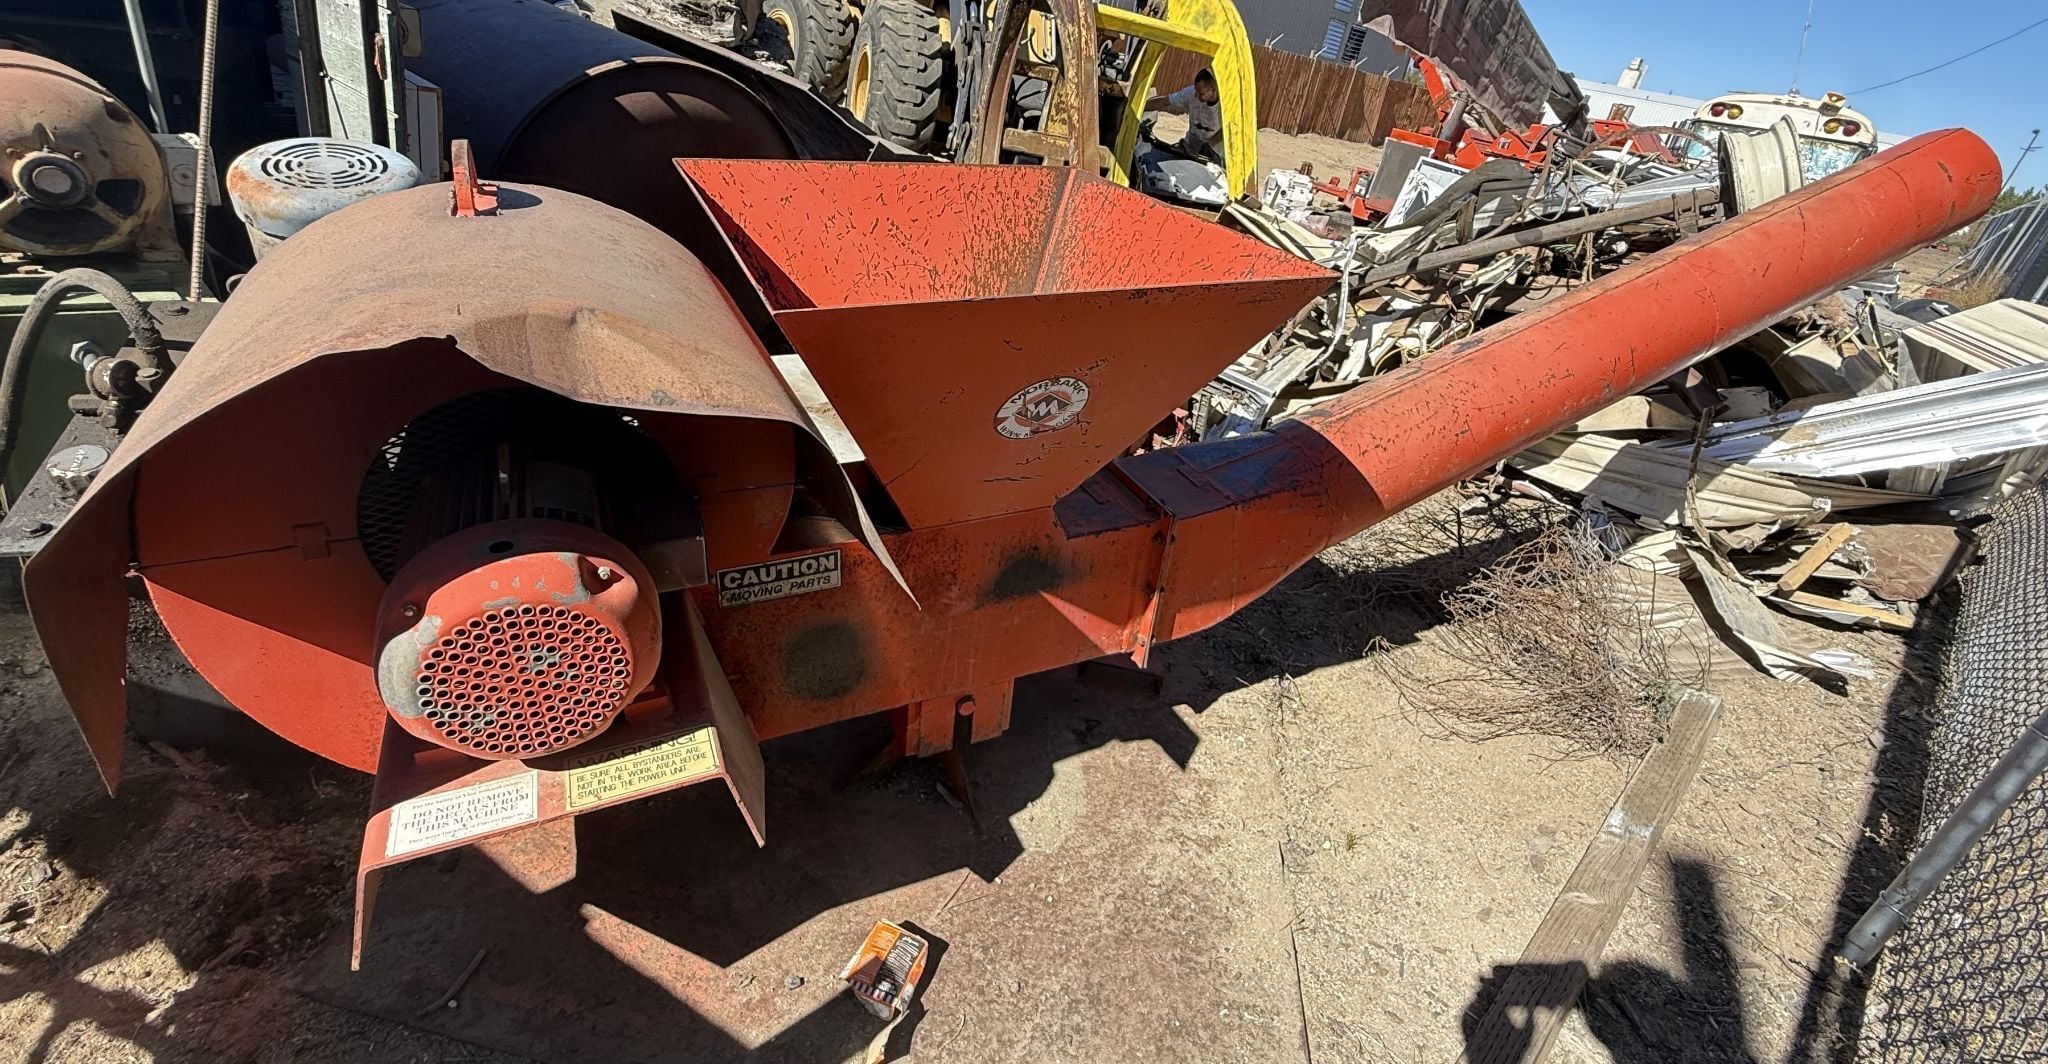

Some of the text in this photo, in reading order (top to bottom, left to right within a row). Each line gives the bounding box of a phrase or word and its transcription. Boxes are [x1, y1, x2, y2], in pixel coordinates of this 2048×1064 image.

[1010, 380, 1085, 404] MORBARK
[724, 555, 835, 588] CAUTION
[730, 575, 832, 604] MOVING PARTS
[577, 745, 701, 783] BE SURE ALL BYSTANDERS ARE
[577, 752, 708, 791] NOT IN THE WORK AREA BEFORE
[577, 784, 617, 800] STARTING
[621, 778, 635, 788] THE
[638, 770, 667, 784] POWER
[401, 818, 432, 830] THE
[435, 804, 489, 822] DECALS
[493, 793, 530, 809] FROM
[414, 810, 432, 819] DO
[437, 801, 464, 813] NOT
[468, 786, 525, 806] REMOVE
[417, 821, 449, 834] THIS
[453, 804, 519, 825] MACHINE
